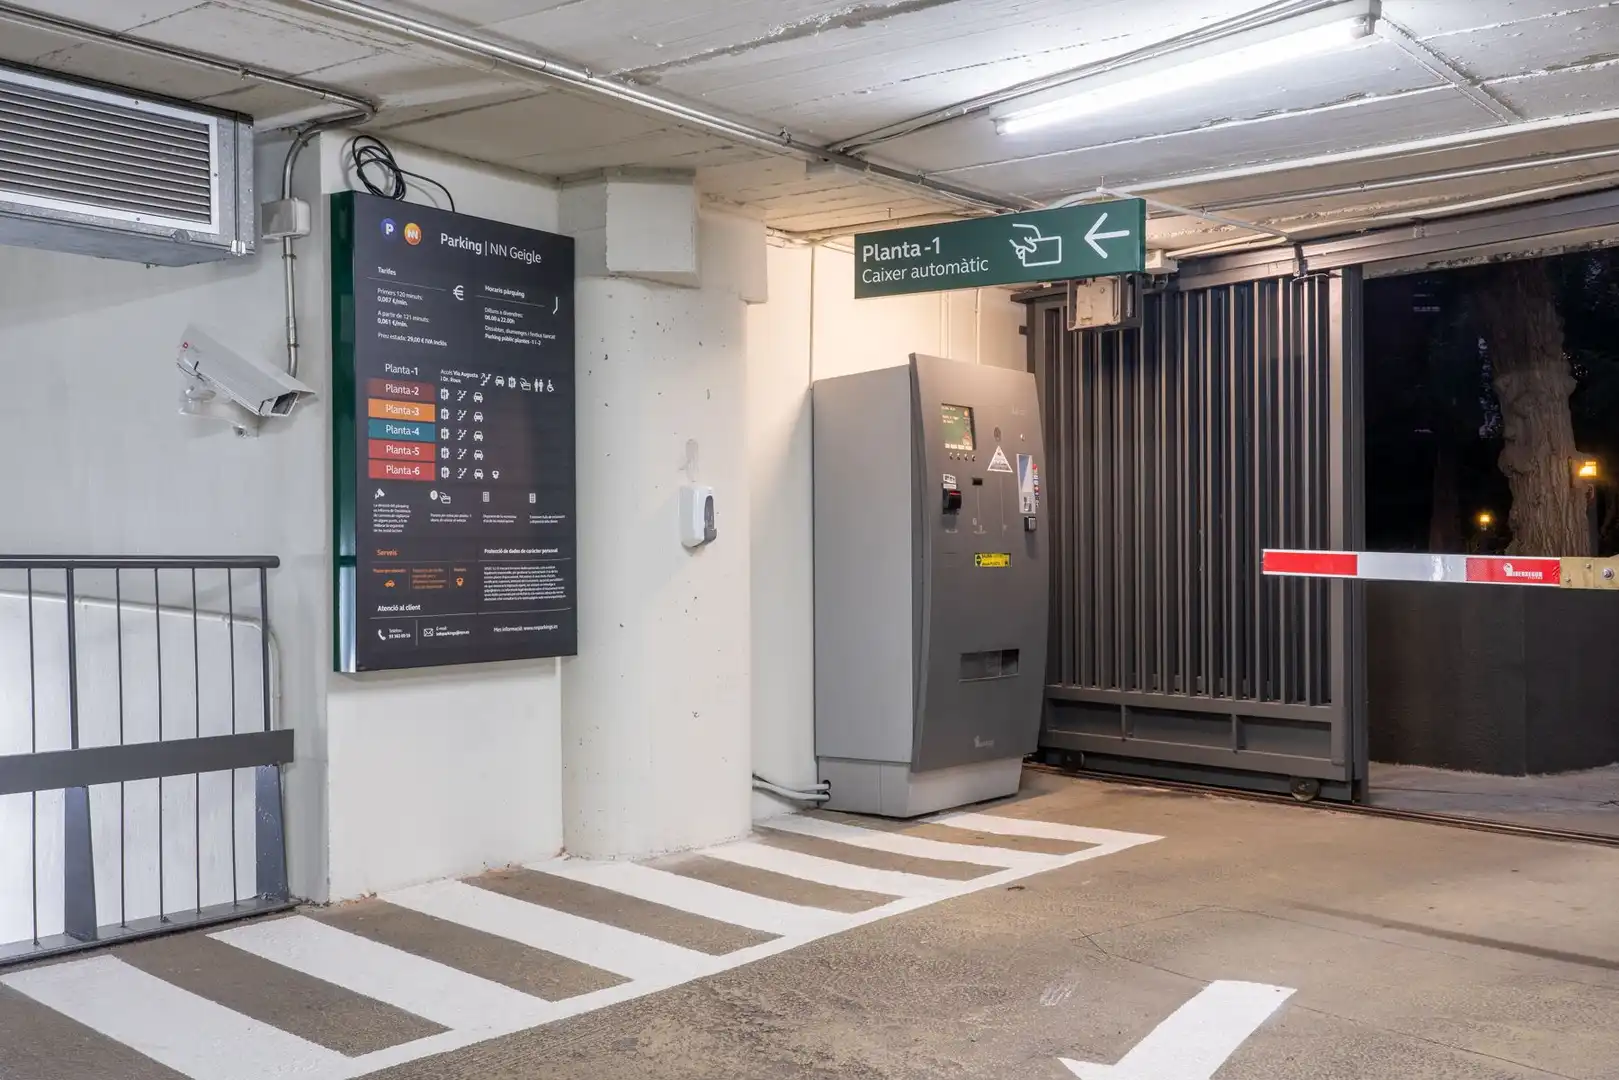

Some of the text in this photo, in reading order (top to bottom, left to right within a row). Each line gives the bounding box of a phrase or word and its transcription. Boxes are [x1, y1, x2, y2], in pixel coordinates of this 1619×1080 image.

[385, 223, 394, 235] P
[440, 232, 542, 264] Parking NN Geigle
[862, 236, 941, 263] Planta -1
[378, 266, 396, 276] Tarifes
[862, 256, 989, 284] Caixer automàtic
[485, 285, 502, 294] Horaris
